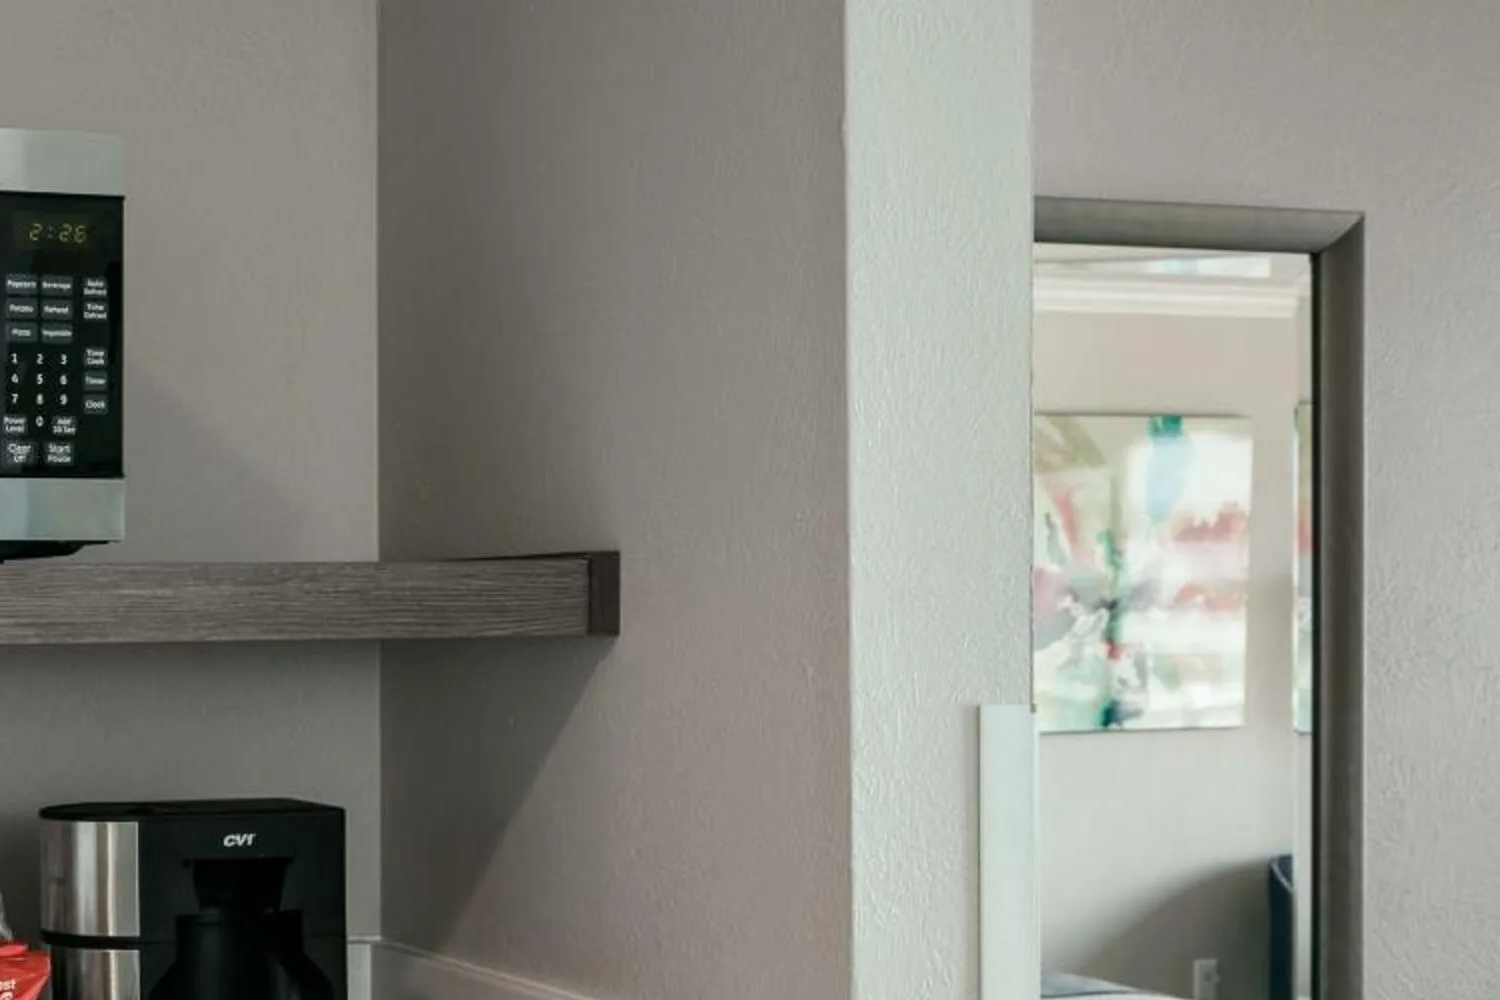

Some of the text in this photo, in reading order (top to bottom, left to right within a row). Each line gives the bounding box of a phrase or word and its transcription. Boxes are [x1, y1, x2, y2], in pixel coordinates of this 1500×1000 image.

[29, 223, 87, 243] 2:26
[11, 353, 18, 365] 1
[36, 353, 44, 365] 2
[60, 354, 67, 365] 3
[11, 374, 19, 383] 4
[36, 374, 43, 385] 5
[60, 375, 67, 385] 6
[11, 394, 19, 404] 7
[36, 394, 44, 405] 8
[60, 394, 67, 405] 9
[36, 416, 44, 427] 0
[48, 444, 71, 453] Start
